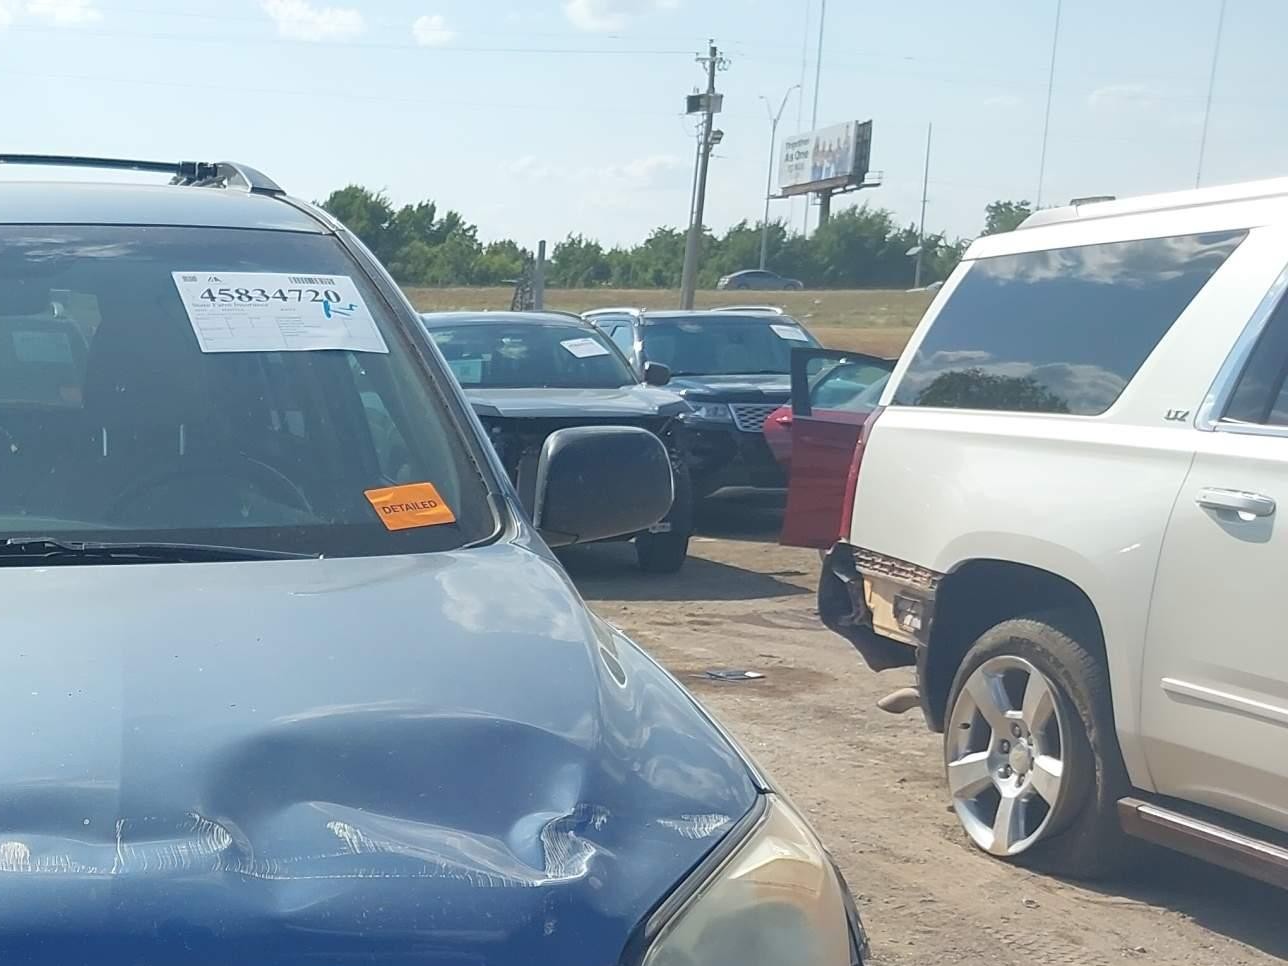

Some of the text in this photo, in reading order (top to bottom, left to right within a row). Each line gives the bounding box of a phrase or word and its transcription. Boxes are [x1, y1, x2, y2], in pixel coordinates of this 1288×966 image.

[200, 287, 341, 303] 45834720
[1164, 409, 1189, 422] LTZ
[382, 500, 438, 515] DETAILED
